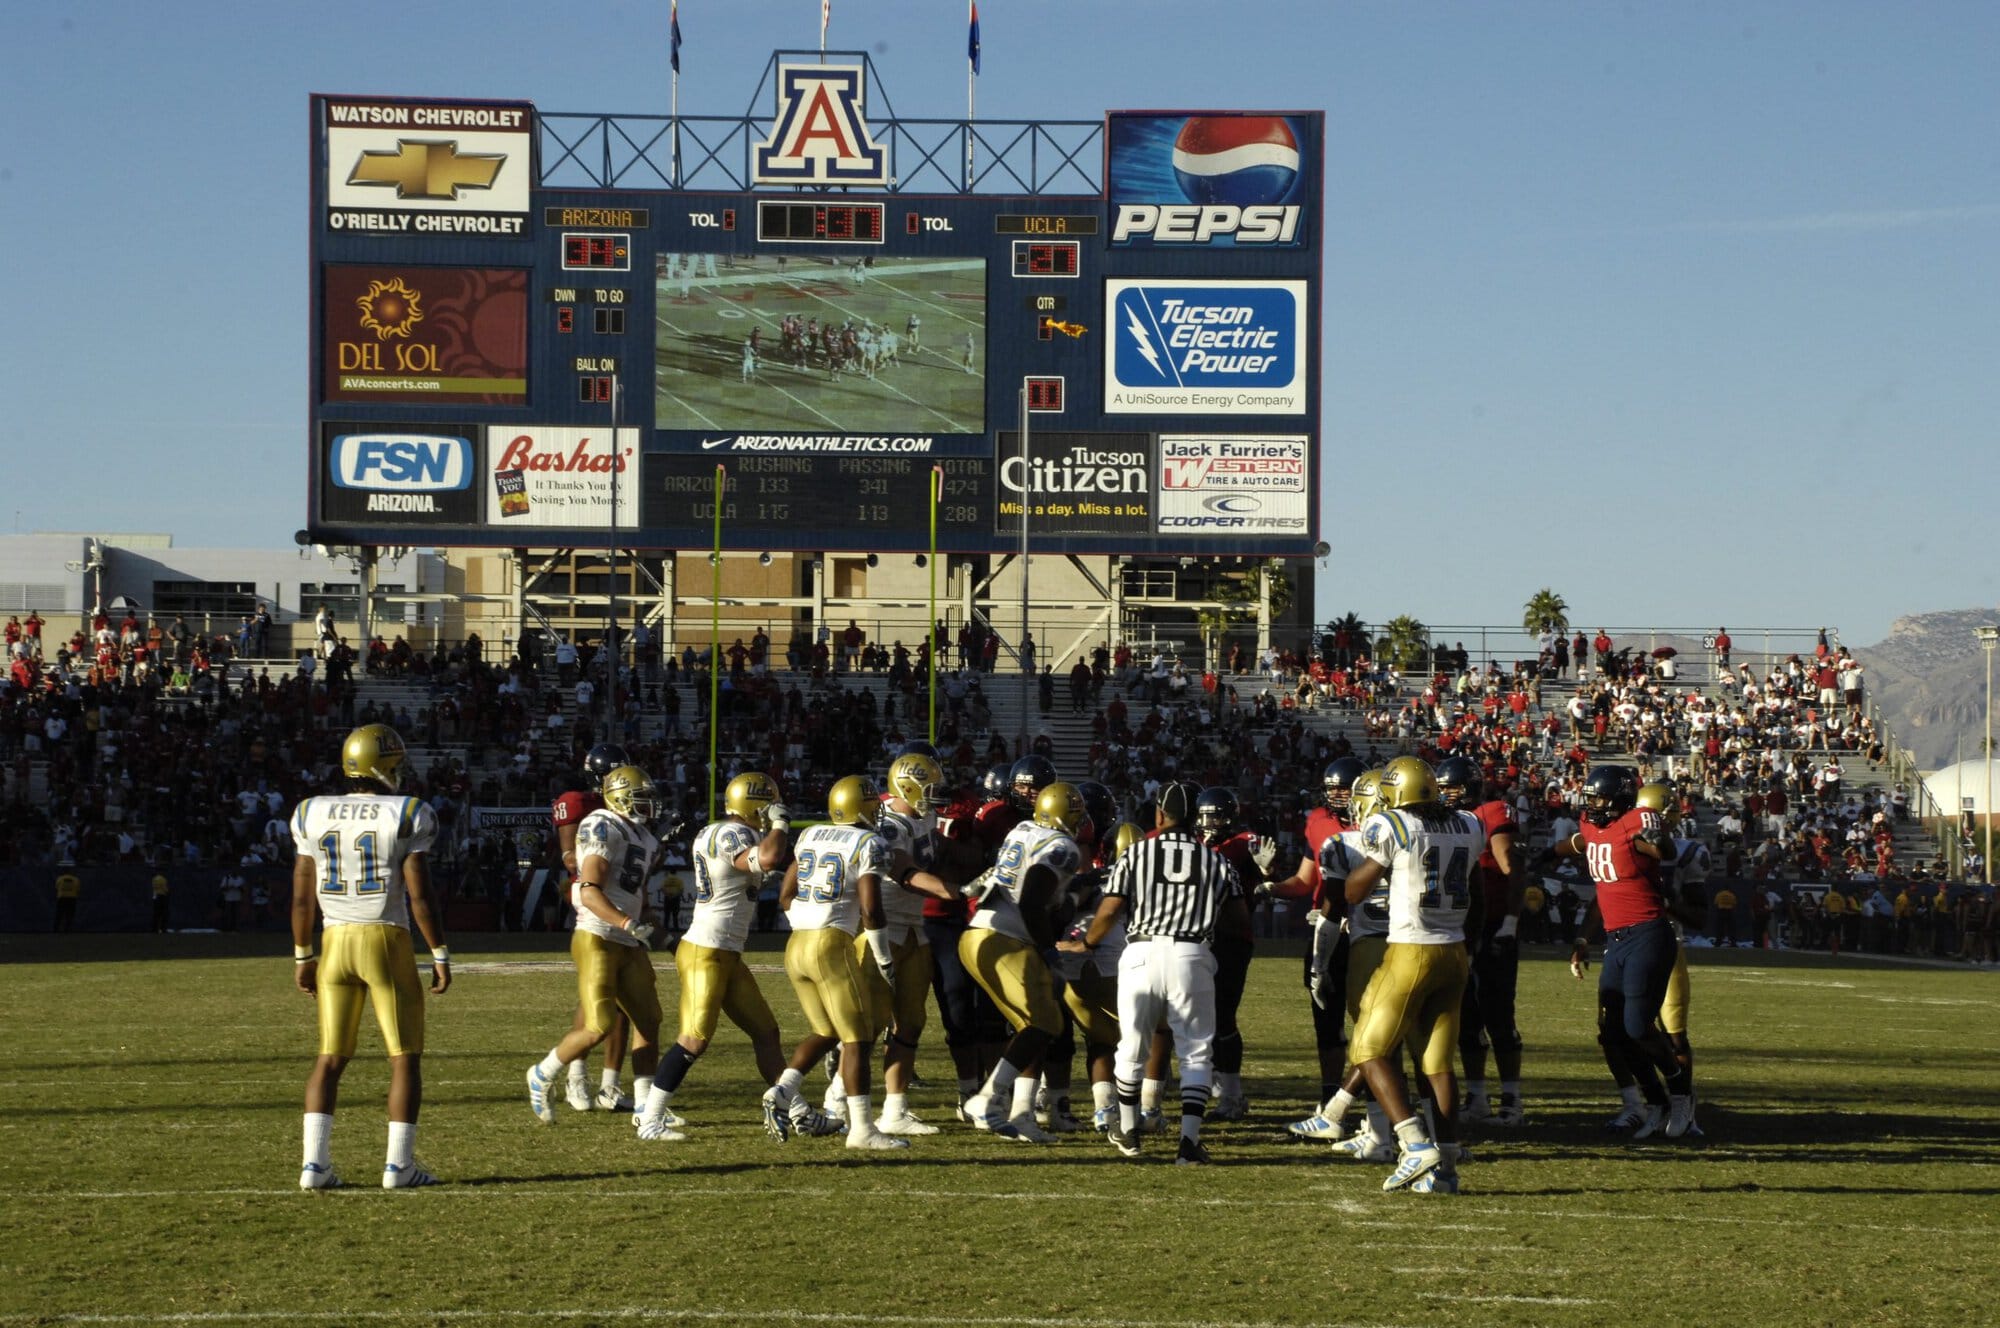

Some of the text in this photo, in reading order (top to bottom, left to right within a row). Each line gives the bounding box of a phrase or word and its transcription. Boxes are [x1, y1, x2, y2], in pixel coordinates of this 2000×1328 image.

[331, 106, 522, 127] WATSON CHEVROLET
[330, 213, 523, 233] O'RIELLY CHEVROLET
[562, 209, 632, 226] ARIZONA
[688, 213, 720, 227] TOL
[922, 217, 953, 231] TOL
[1024, 217, 1066, 233] UCLA
[1112, 204, 1301, 242] PEPSI
[566, 238, 614, 266] 34
[1029, 244, 1076, 273] 27
[554, 288, 576, 303] DWN
[595, 290, 624, 304] TO GO
[1036, 297, 1056, 310] QTR
[1161, 299, 1254, 324] Tucson
[1169, 326, 1278, 349] Electric
[339, 342, 442, 372] DEL SOL
[577, 358, 615, 371] BALL ON
[1180, 349, 1278, 374] Power
[343, 378, 440, 390] AVAconcerts.com
[1114, 394, 1295, 409] A UniSource Energy Company
[731, 435, 932, 452] ARIZONAATHLETICS.COM
[1165, 443, 1302, 457] Jack Furrier's
[353, 441, 450, 482] FSN
[494, 435, 634, 473] Bashas'
[1071, 447, 1145, 465] Tucson
[739, 457, 812, 473] RUSHING
[838, 458, 912, 474] PASSING
[1164, 458, 1302, 488] WESTERN
[1000, 456, 1148, 493] Citizen
[1206, 476, 1300, 487] TIRE & AUTO CARE
[535, 480, 543, 490] It
[547, 480, 585, 491] Thanks
[587, 481, 606, 491] You
[664, 476, 737, 492] ARIZOA
[759, 477, 790, 493] 133
[858, 479, 889, 495] 341
[367, 494, 434, 512] ARIZONA
[531, 495, 565, 506] Saving
[568, 496, 587, 505] You
[944, 506, 978, 522] 288
[1035, 505, 1044, 514] a
[1047, 504, 1075, 516] day.
[1078, 504, 1111, 514] Miss
[1114, 506, 1123, 515] a
[1126, 504, 1148, 515] lot.
[1704, 637, 1716, 648] 30
[328, 804, 380, 820] KEYES
[319, 830, 386, 895] 11
[1161, 841, 1196, 882] U
[1586, 842, 1620, 882] 88
[797, 849, 845, 903] 23
[1420, 846, 1469, 909] 14
